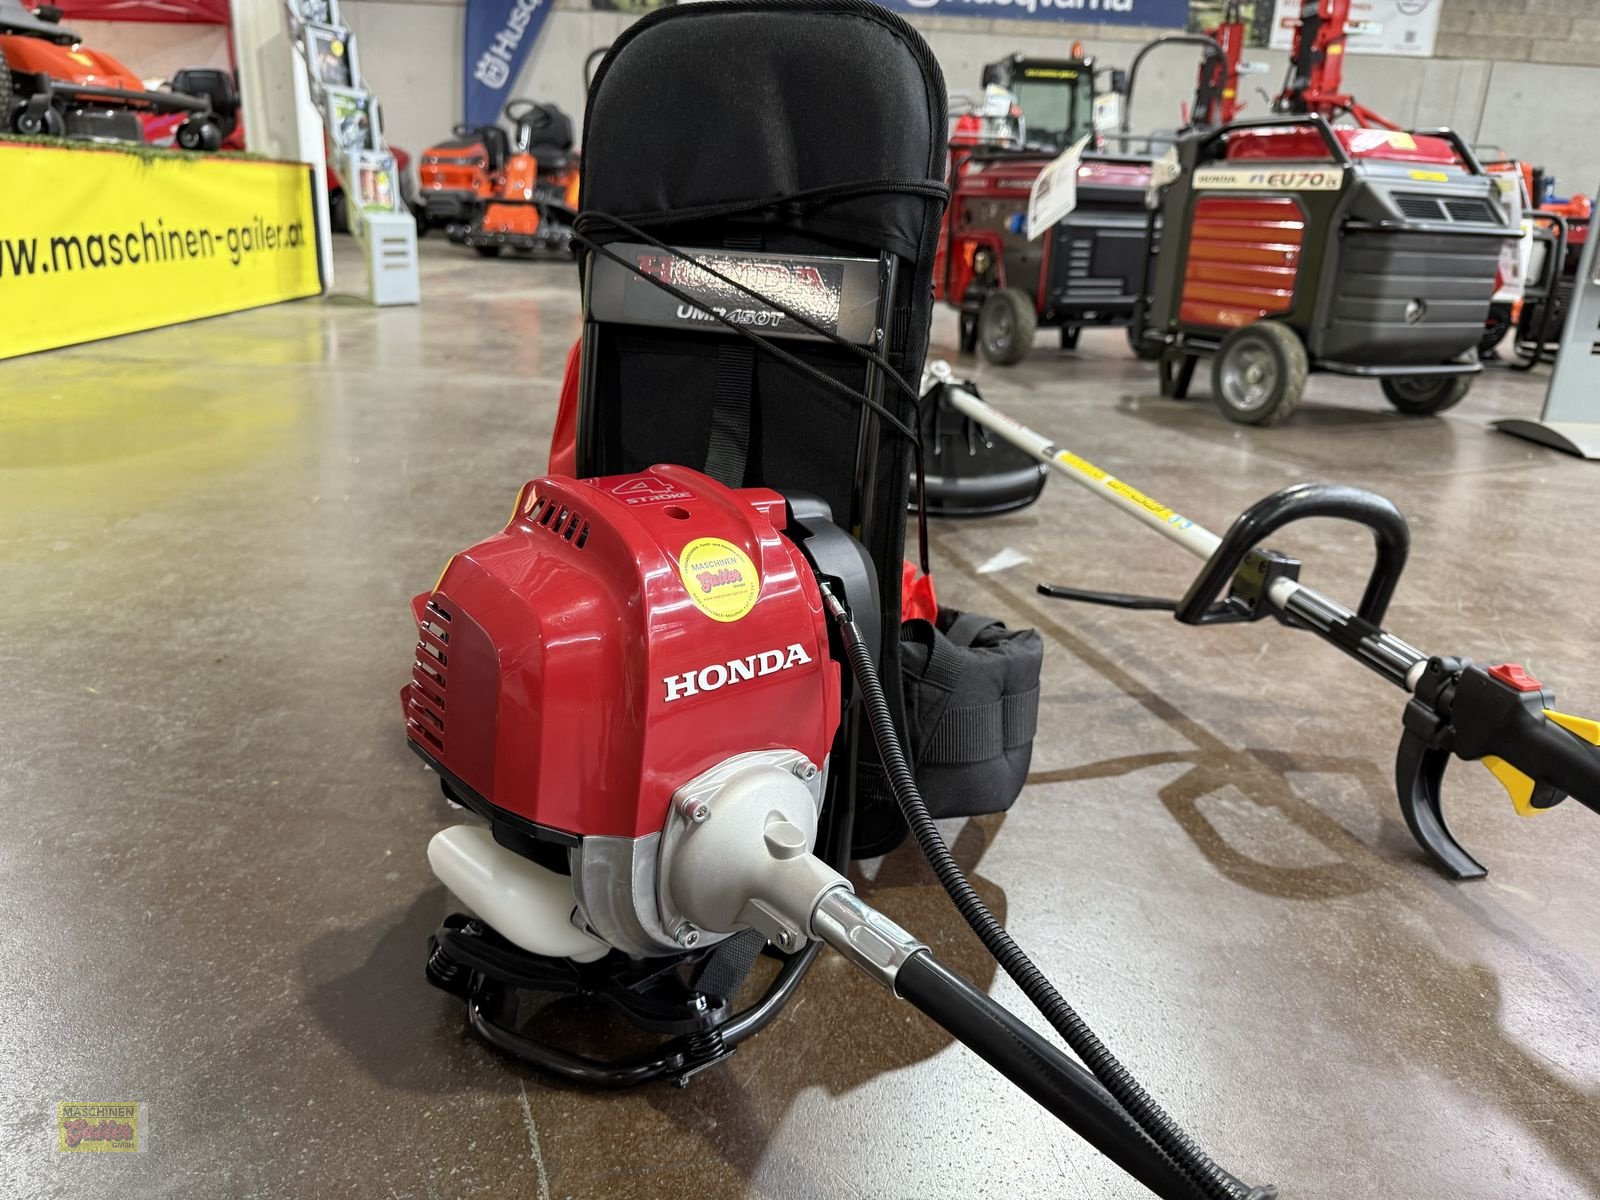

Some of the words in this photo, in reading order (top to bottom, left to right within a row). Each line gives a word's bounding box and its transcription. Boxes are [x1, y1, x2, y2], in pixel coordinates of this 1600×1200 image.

[0, 215, 305, 277] w.maschinen-gailer.at
[677, 304, 785, 327] UMP450T
[612, 477, 674, 494] 4
[626, 491, 692, 505] STROKE
[691, 556, 737, 572] MASCHINEN
[663, 643, 812, 702] HONDA
